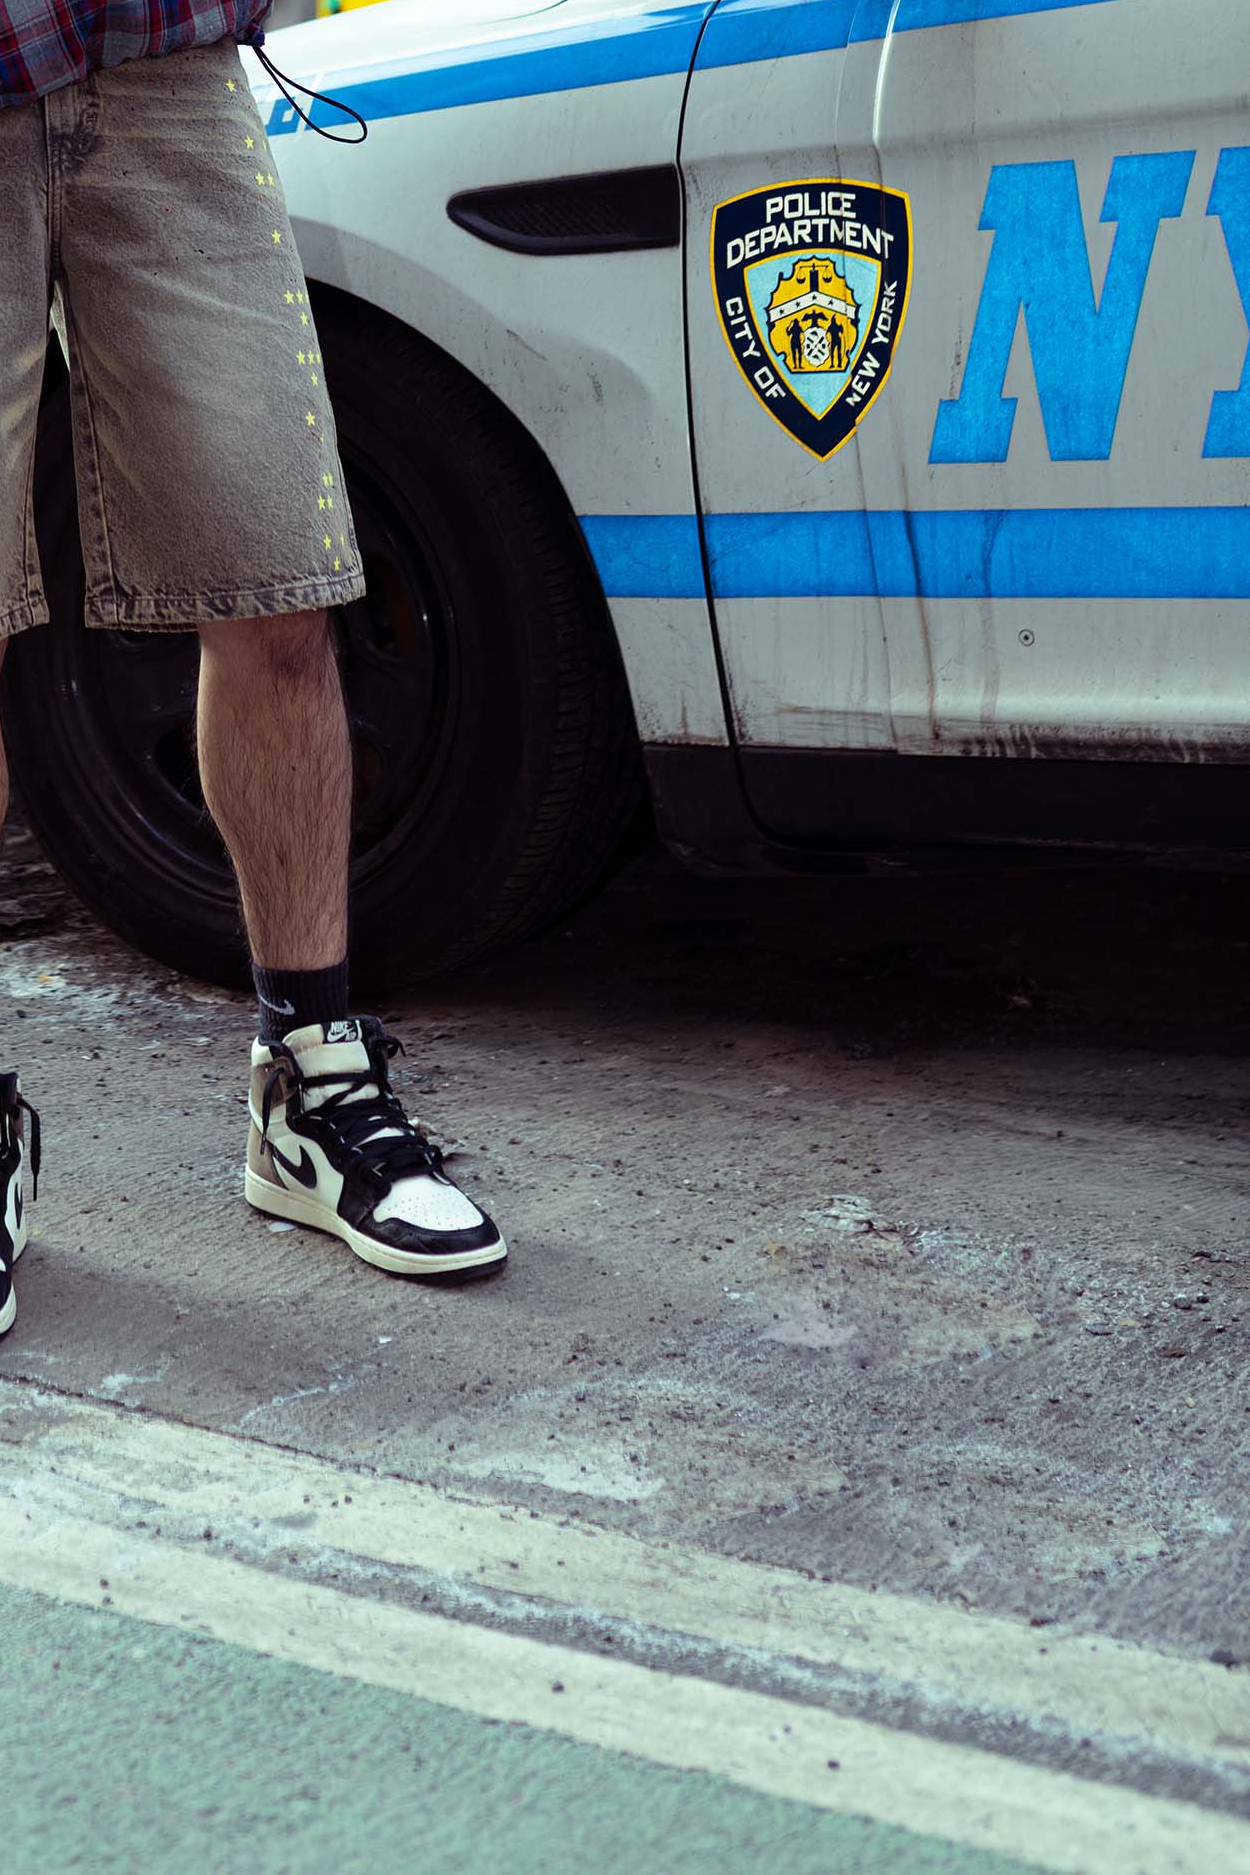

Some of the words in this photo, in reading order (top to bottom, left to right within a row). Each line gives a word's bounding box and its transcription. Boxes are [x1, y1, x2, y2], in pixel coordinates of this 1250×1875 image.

[726, 218, 895, 270] DEPARTMENT
[765, 190, 857, 224] POLICE
[725, 296, 761, 358] CITY
[753, 365, 786, 399] OF
[845, 351, 881, 408] NEW
[871, 280, 898, 344] YORK
